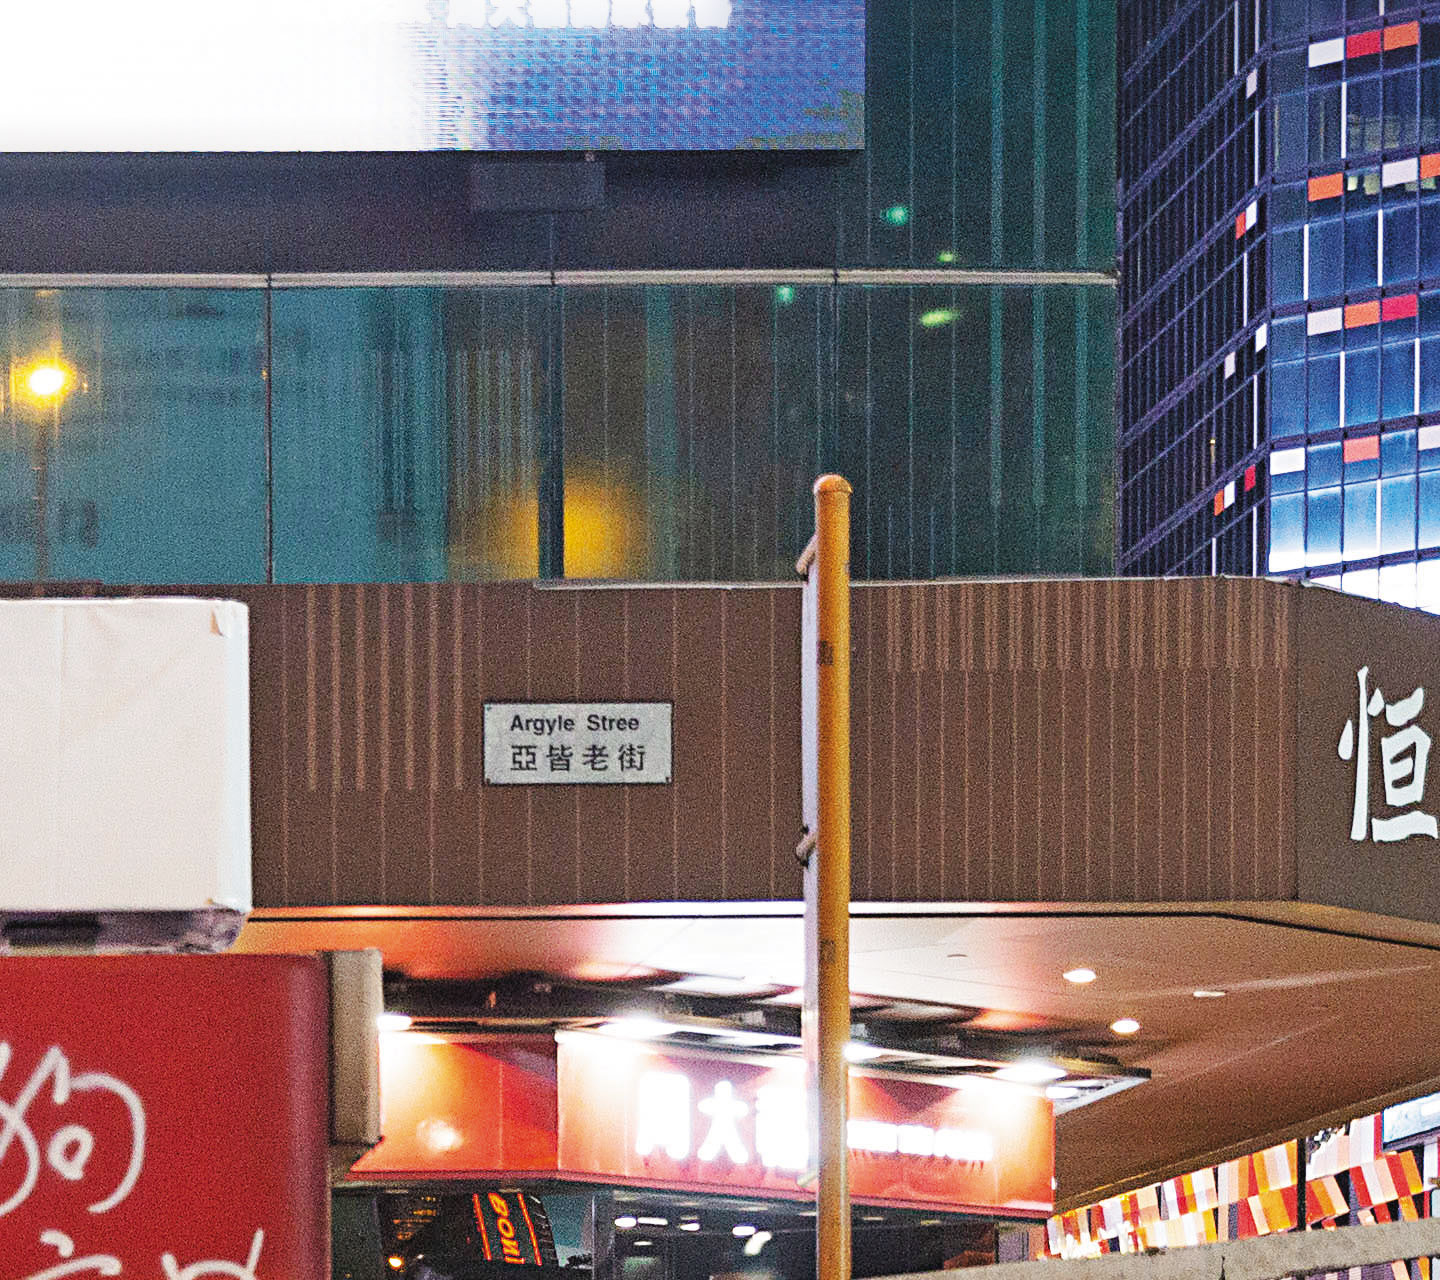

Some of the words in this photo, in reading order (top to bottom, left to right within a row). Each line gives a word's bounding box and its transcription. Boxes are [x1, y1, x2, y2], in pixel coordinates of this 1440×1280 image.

[510, 715, 576, 736] Argyle
[587, 714, 640, 731] Stree
[510, 744, 646, 772] 亞皆老街
